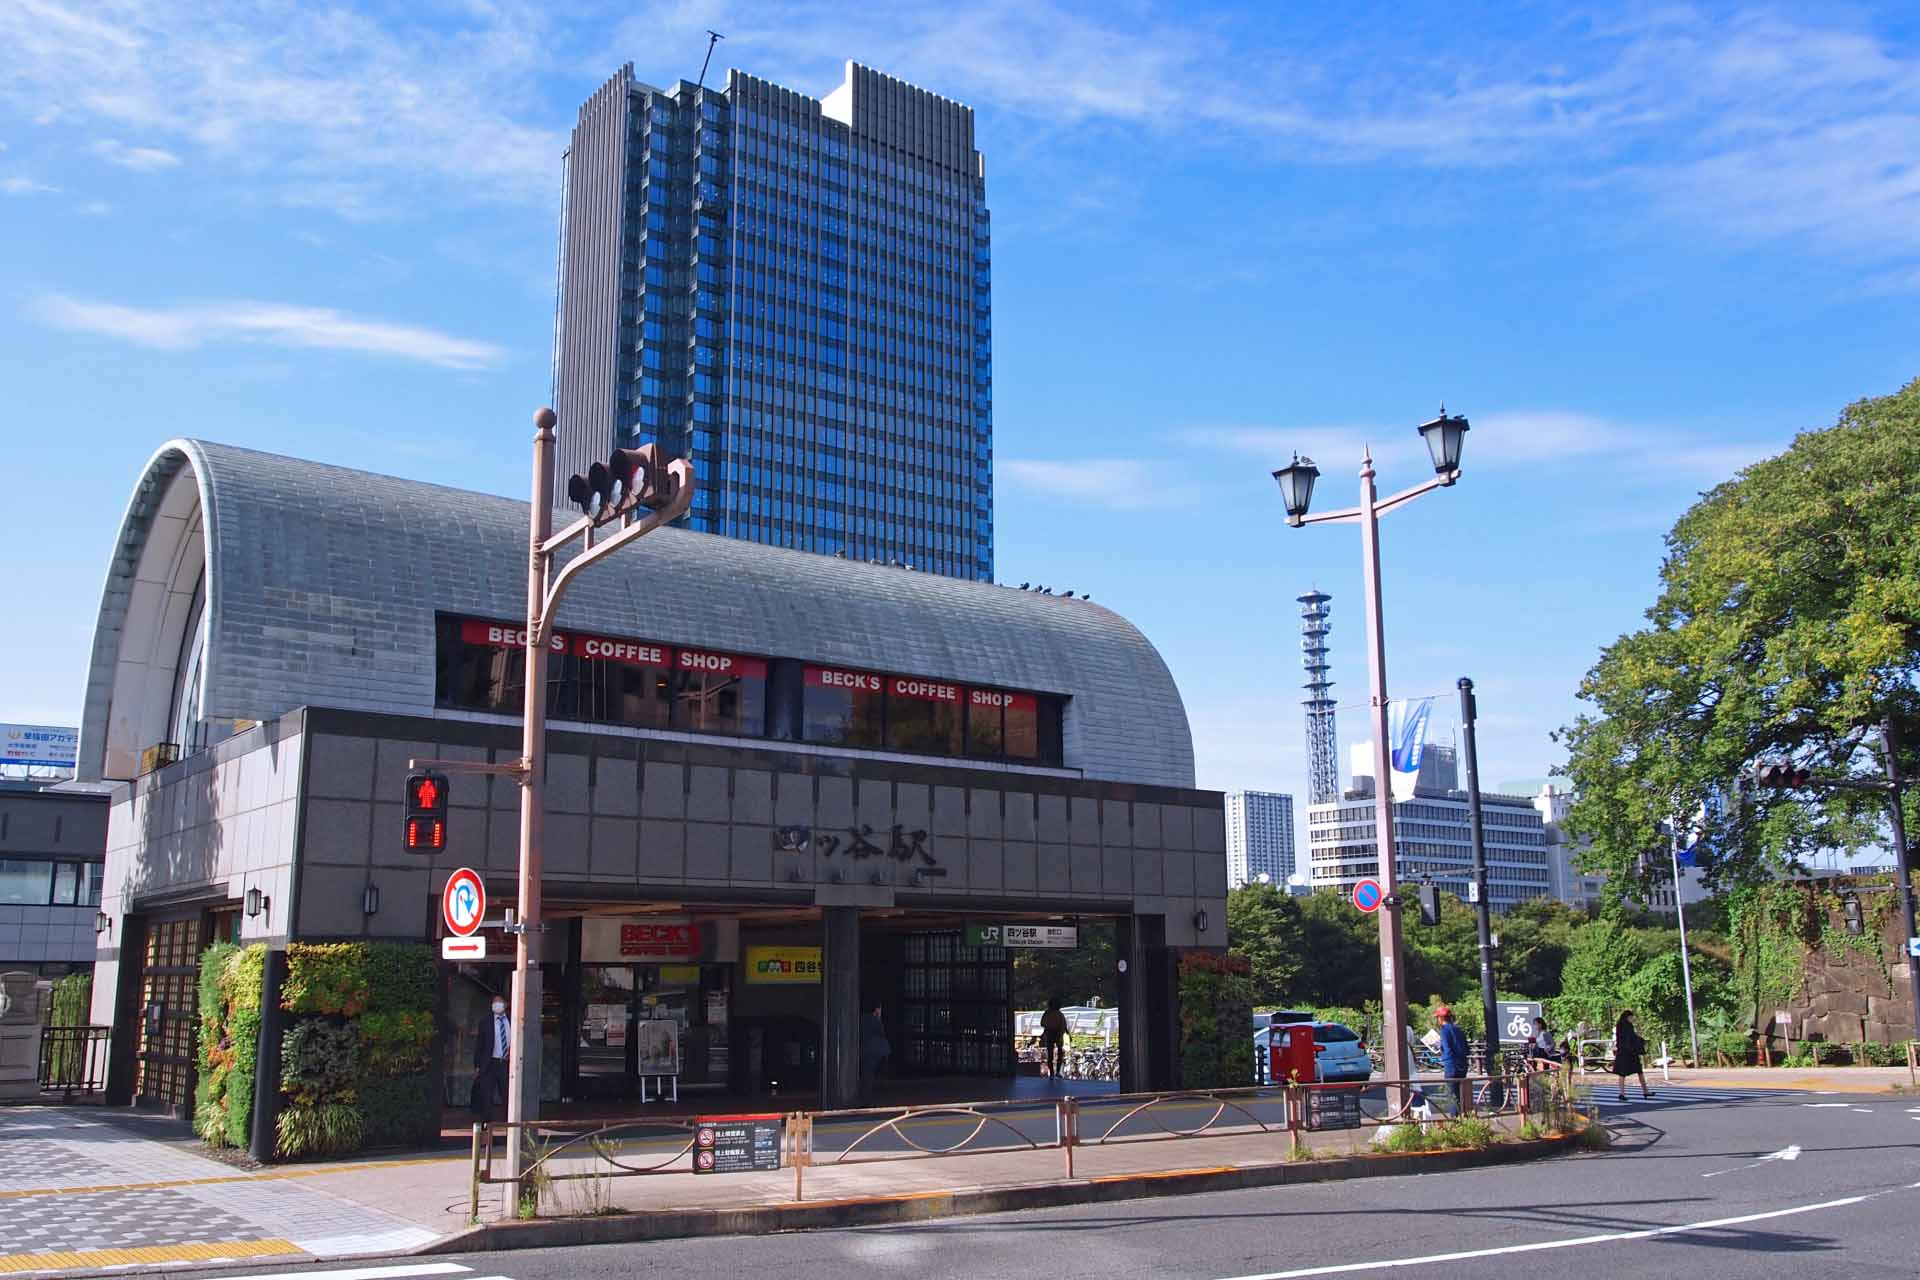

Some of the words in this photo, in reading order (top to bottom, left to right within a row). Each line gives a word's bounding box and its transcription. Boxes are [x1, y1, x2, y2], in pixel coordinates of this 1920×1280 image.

[488, 626, 565, 650] BECS
[585, 639, 662, 663] COFFEE
[681, 651, 732, 671] SHOP
[821, 670, 881, 690] BECK'S
[896, 680, 956, 700] COFFEE
[971, 690, 1013, 707] SHOP
[621, 924, 702, 944] BECK
[981, 927, 999, 941] JR
[1007, 927, 1037, 938] 四ツ谷駅
